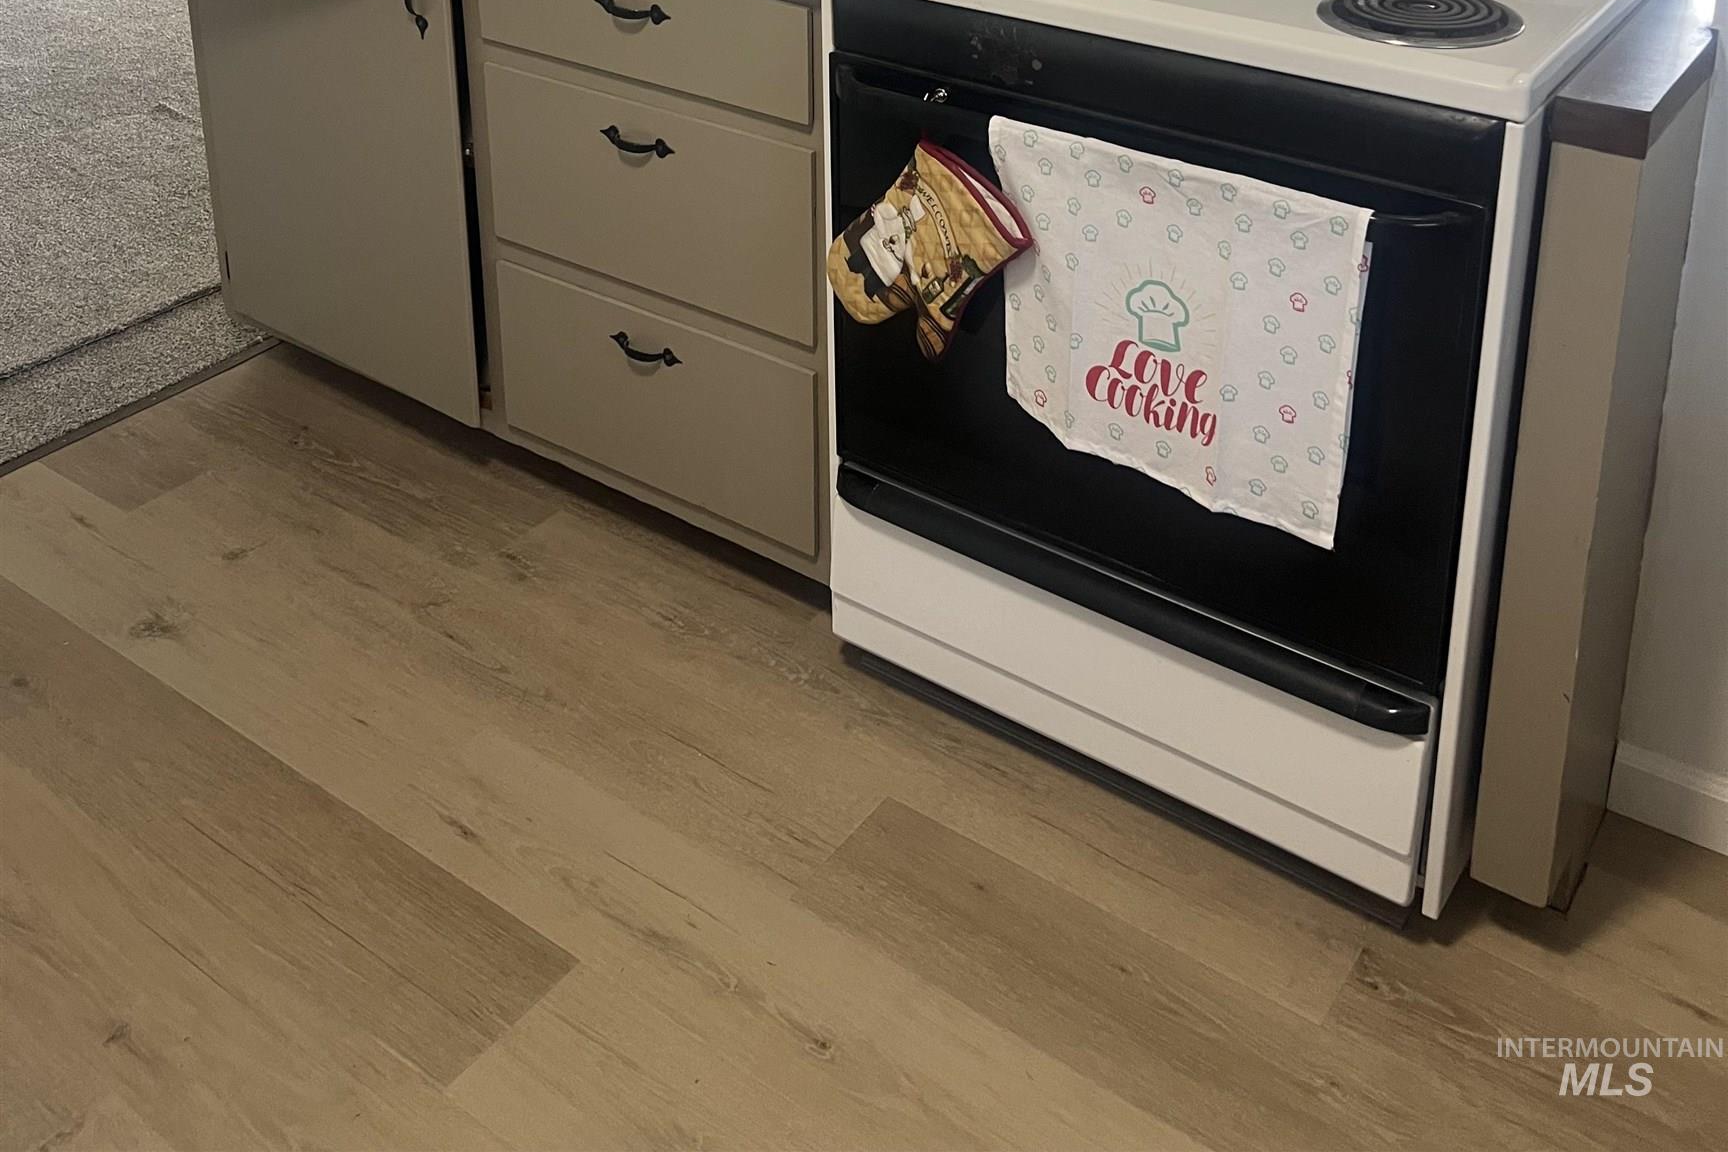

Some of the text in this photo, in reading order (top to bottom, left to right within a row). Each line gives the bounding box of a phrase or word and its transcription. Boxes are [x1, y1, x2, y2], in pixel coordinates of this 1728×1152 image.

[918, 188, 953, 252] WELCOME
[1108, 339, 1208, 404] Love
[1085, 365, 1217, 446] Cooking
